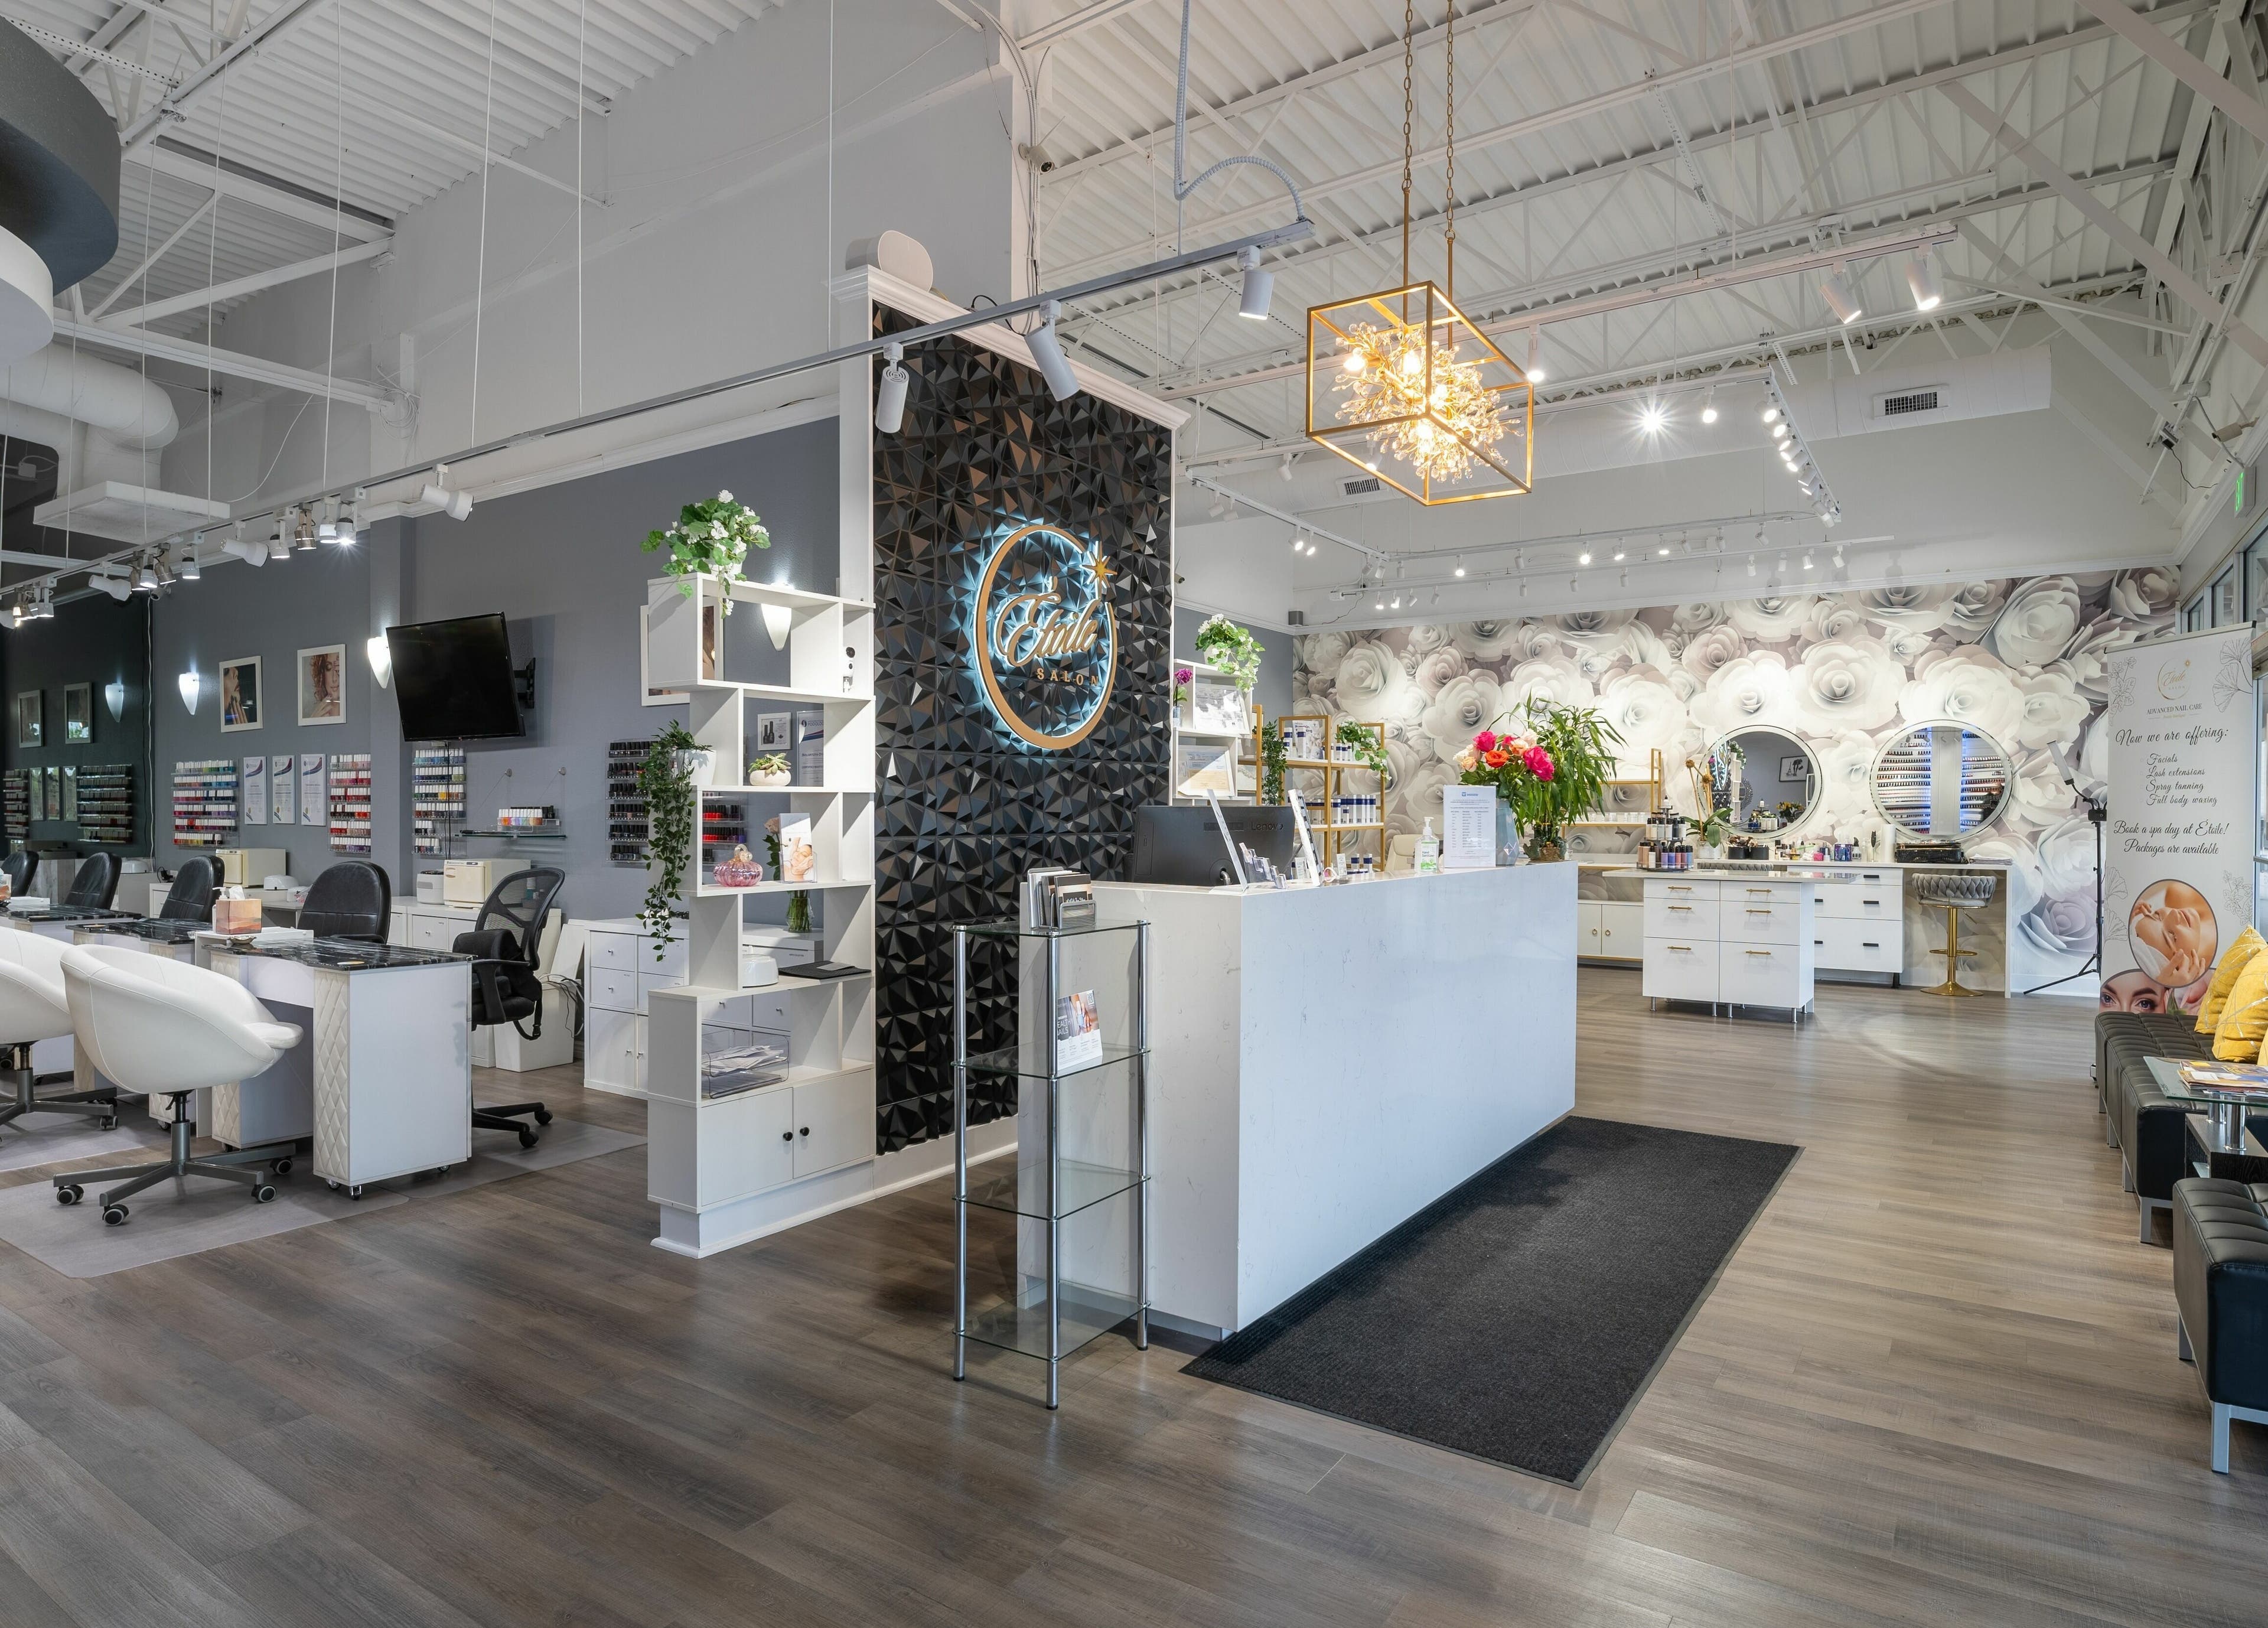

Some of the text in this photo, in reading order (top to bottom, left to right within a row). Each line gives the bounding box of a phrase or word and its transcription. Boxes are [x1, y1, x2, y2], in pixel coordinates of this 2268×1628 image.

[994, 576, 1102, 667] Étoile
[1037, 668, 1099, 686] SALON
[2146, 706, 2174, 715] ADVANCED
[2115, 725, 2228, 746] Now we are offering:
[2147, 753, 2178, 766] Facials
[2146, 766, 2205, 780] Lash extensions
[2146, 779, 2204, 794] Spray tanning
[2146, 793, 2217, 808] Full body waxing
[1251, 821, 1284, 831] Lenovo
[2114, 820, 2139, 834] Book
[2149, 827, 2162, 838] spa
[2165, 823, 2180, 839] day
[2183, 823, 2194, 834] at
[2195, 819, 2230, 836] Étoile!
[2124, 838, 2219, 857] Packages are available
[1057, 1019, 1071, 1028] EALTH
